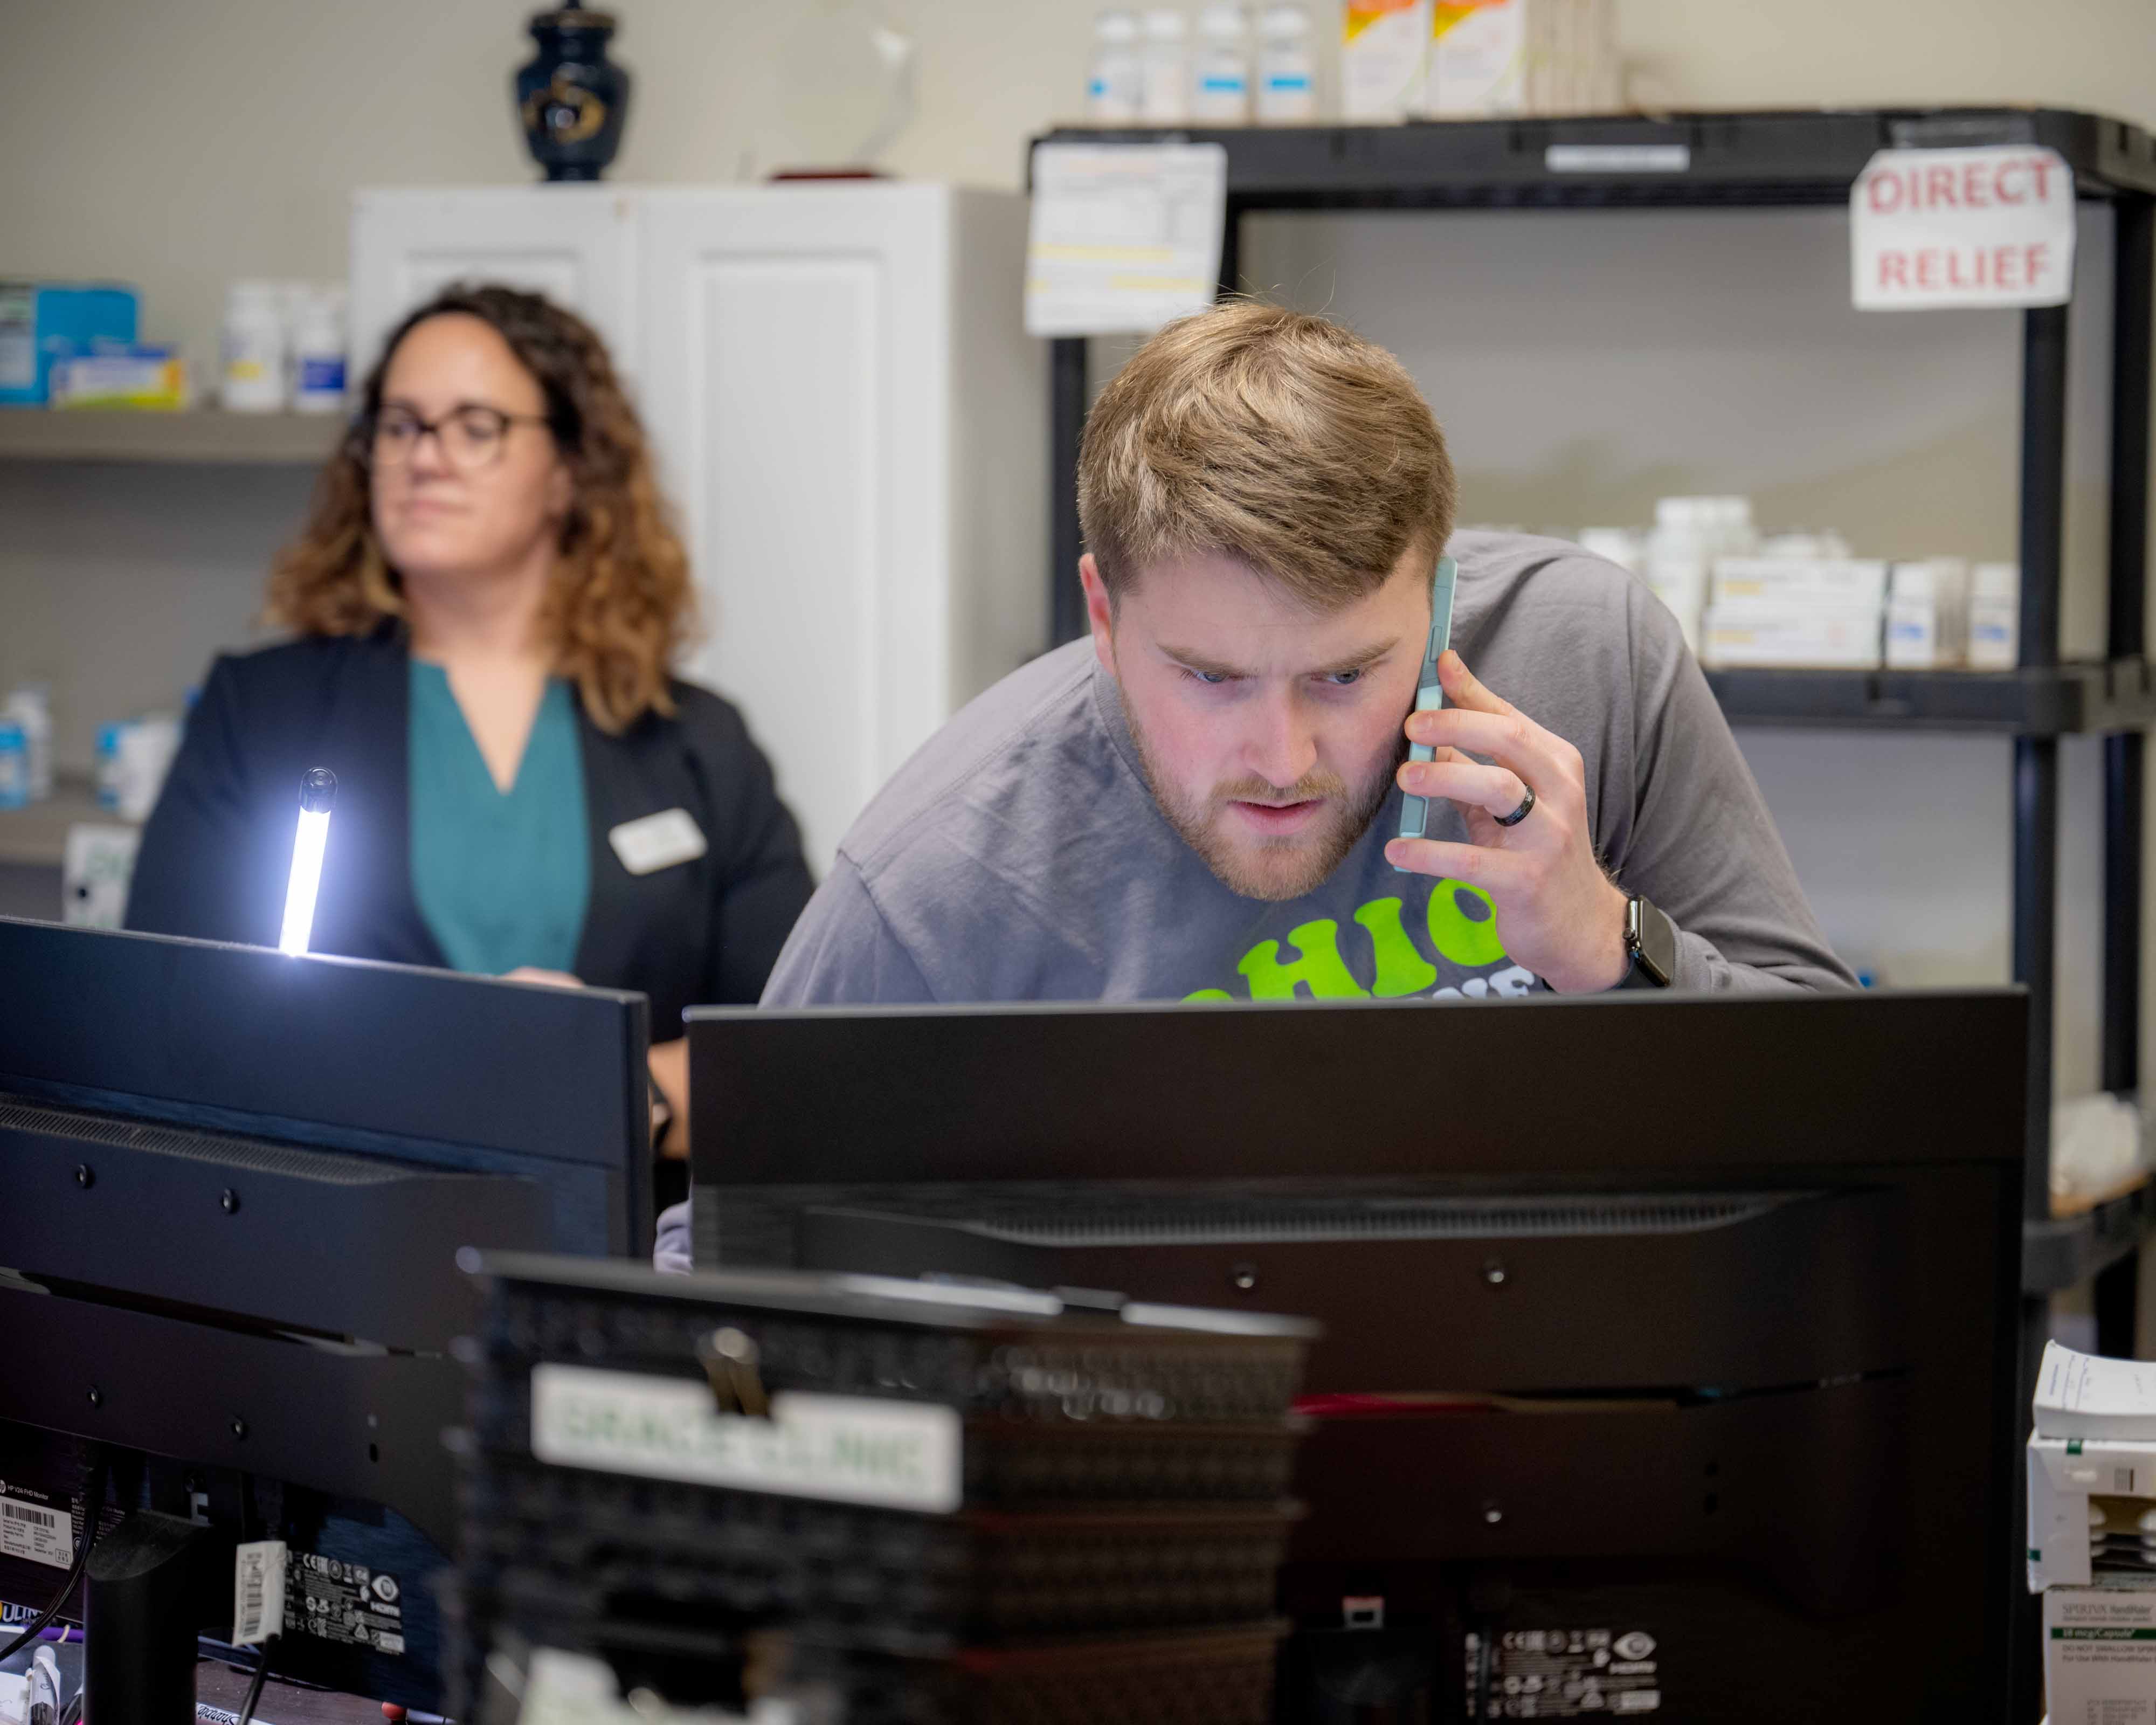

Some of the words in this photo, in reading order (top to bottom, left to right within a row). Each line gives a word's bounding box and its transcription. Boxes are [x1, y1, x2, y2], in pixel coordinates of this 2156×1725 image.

[1866, 155, 2062, 217] DIRECT
[1877, 242, 2051, 292] RELIEF
[1178, 878, 1507, 1002] HIO
[33, 1491, 49, 1500] Monitor
